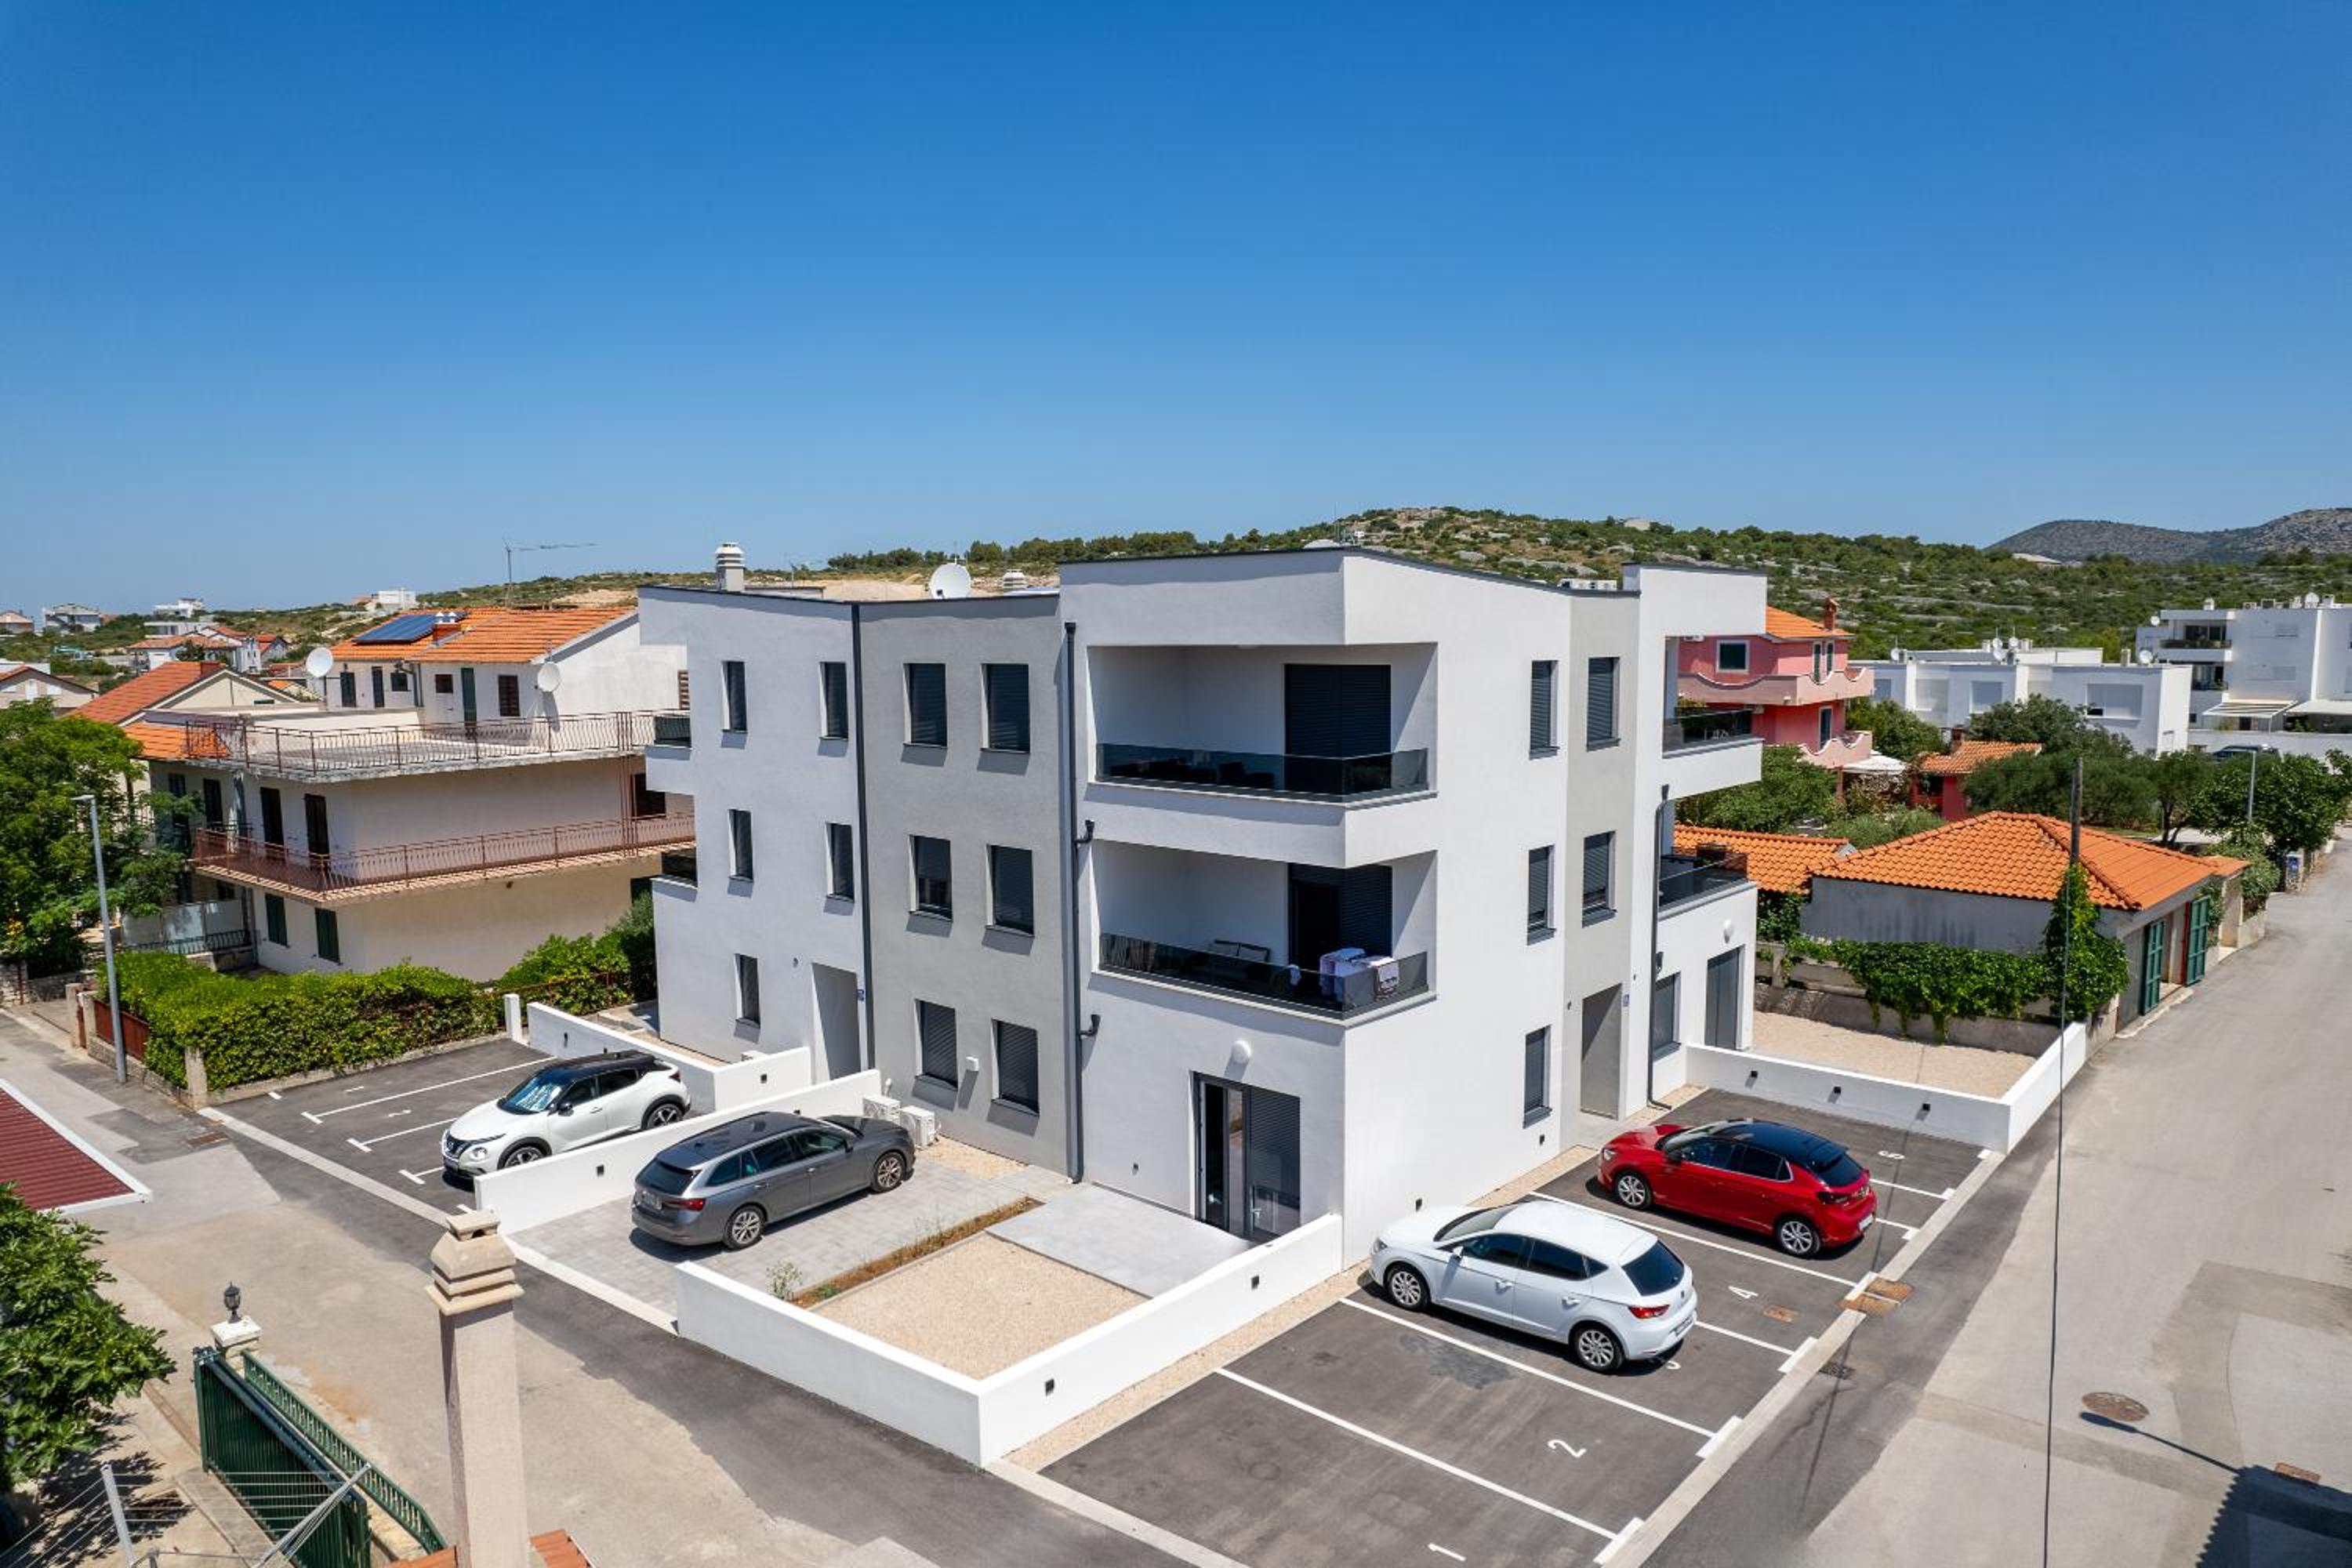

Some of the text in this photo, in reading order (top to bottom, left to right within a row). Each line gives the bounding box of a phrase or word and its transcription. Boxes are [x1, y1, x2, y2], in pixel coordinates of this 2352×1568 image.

[1728, 1285, 1759, 1299] 4
[1548, 1439, 1587, 1458] 2
[1428, 1542, 1466, 1562] 1
